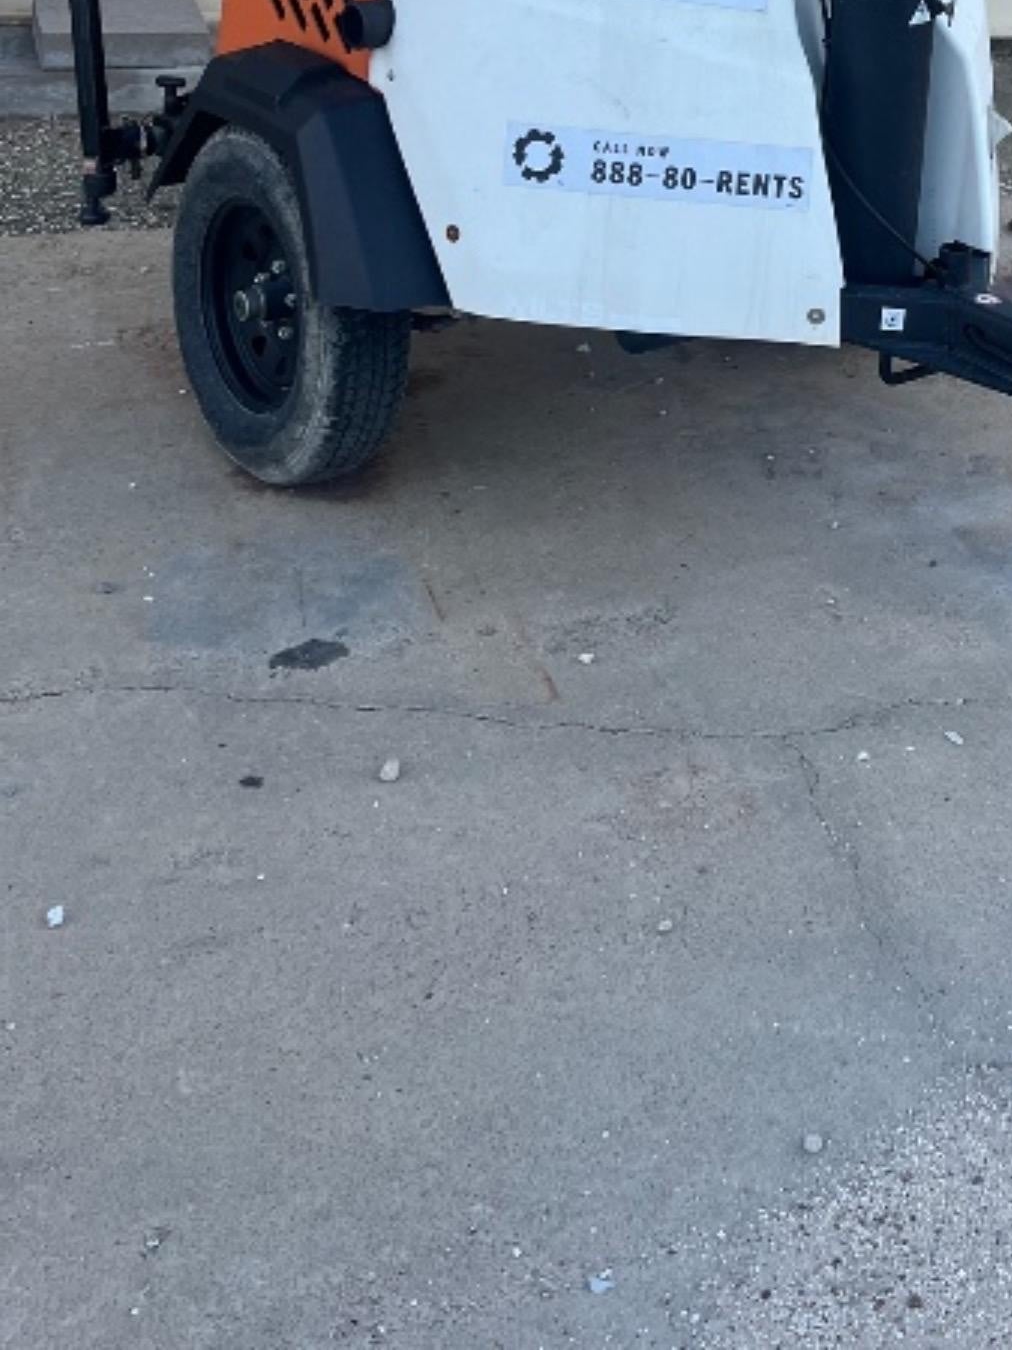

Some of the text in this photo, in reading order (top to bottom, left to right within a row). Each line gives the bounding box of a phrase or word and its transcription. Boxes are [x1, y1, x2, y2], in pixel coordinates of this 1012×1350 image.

[592, 139, 671, 158] CALL NOW
[589, 158, 806, 200] 888-80-RENTS
